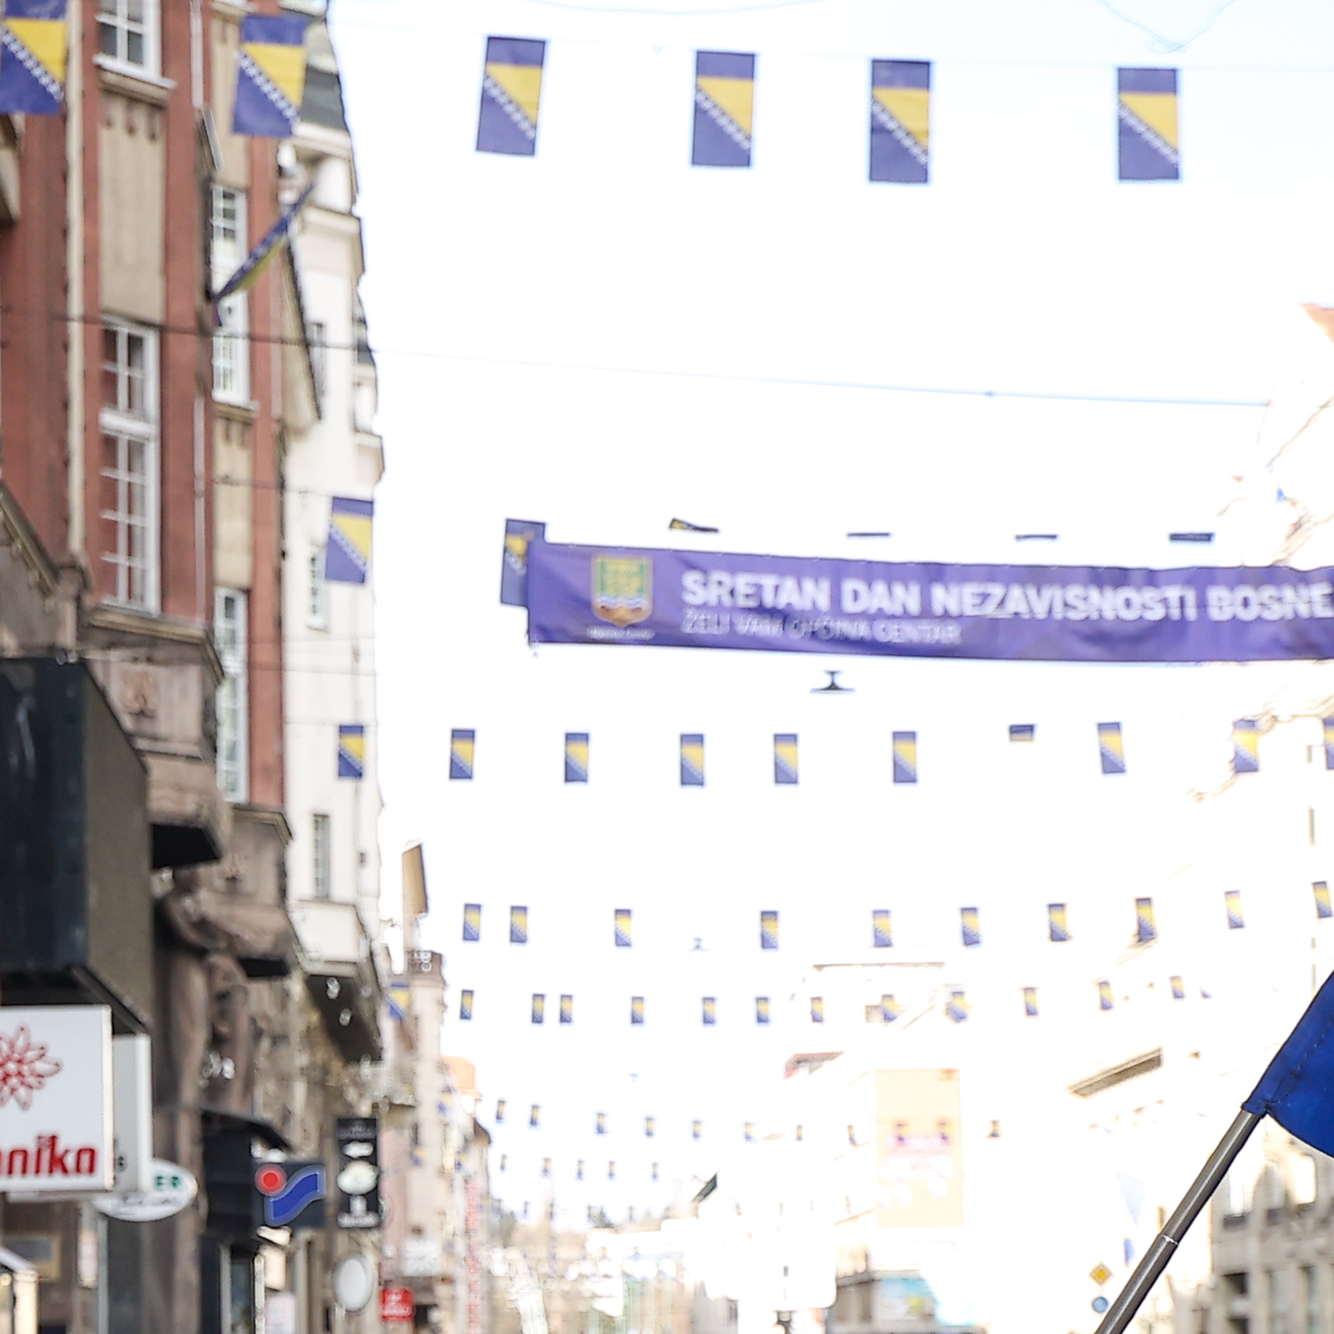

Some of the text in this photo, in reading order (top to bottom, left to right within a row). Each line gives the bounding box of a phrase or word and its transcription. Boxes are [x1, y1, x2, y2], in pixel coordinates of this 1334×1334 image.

[681, 569, 831, 612] SRETAN
[841, 577, 921, 616] DAN
[930, 582, 1198, 622] NEZAVISNOSTI
